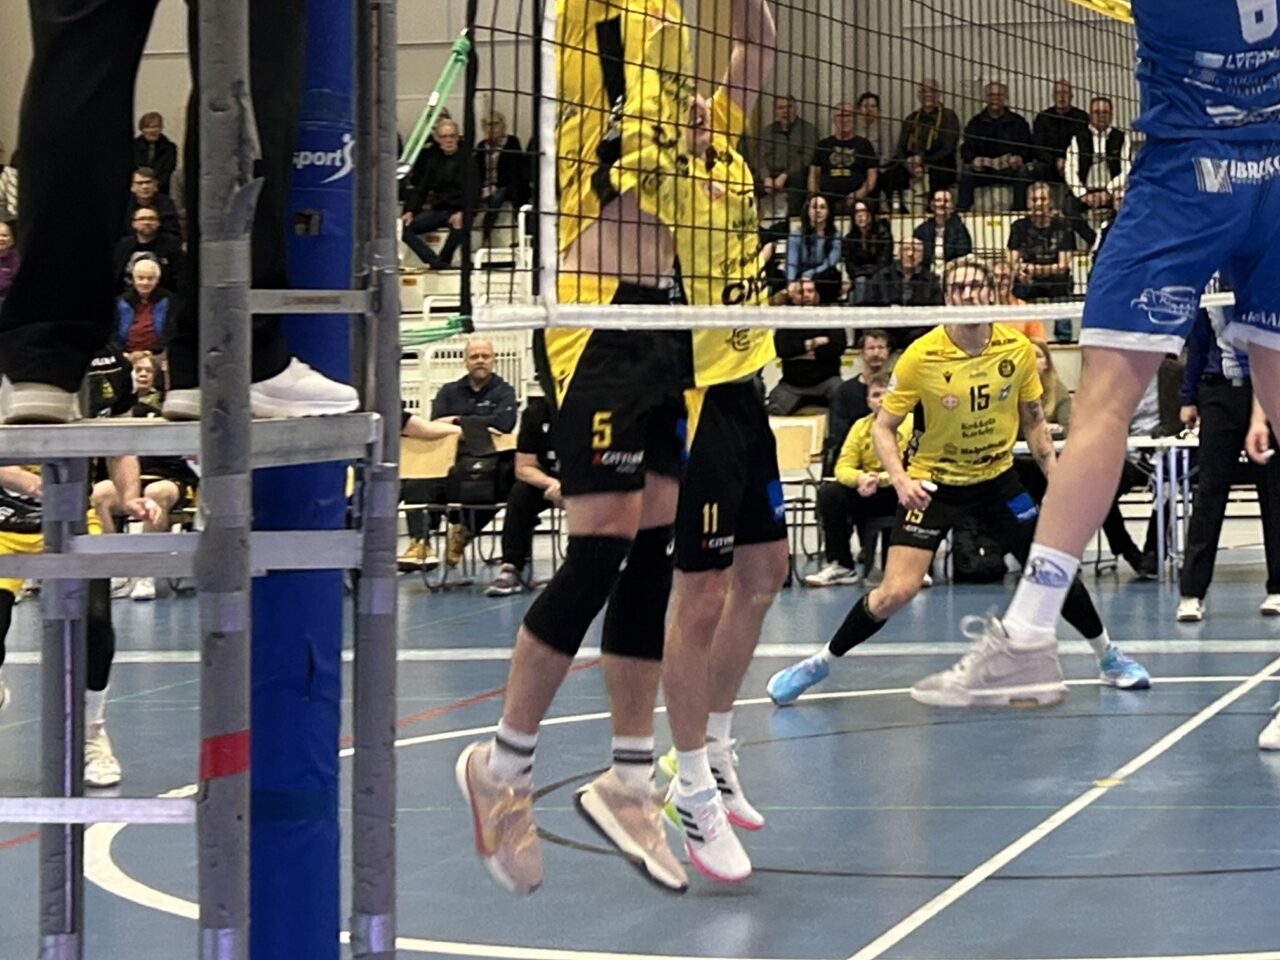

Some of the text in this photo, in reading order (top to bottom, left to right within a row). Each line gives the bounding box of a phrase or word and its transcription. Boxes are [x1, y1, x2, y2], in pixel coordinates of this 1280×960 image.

[969, 383, 991, 413] 15
[591, 411, 613, 450] 5
[701, 502, 718, 535] 11
